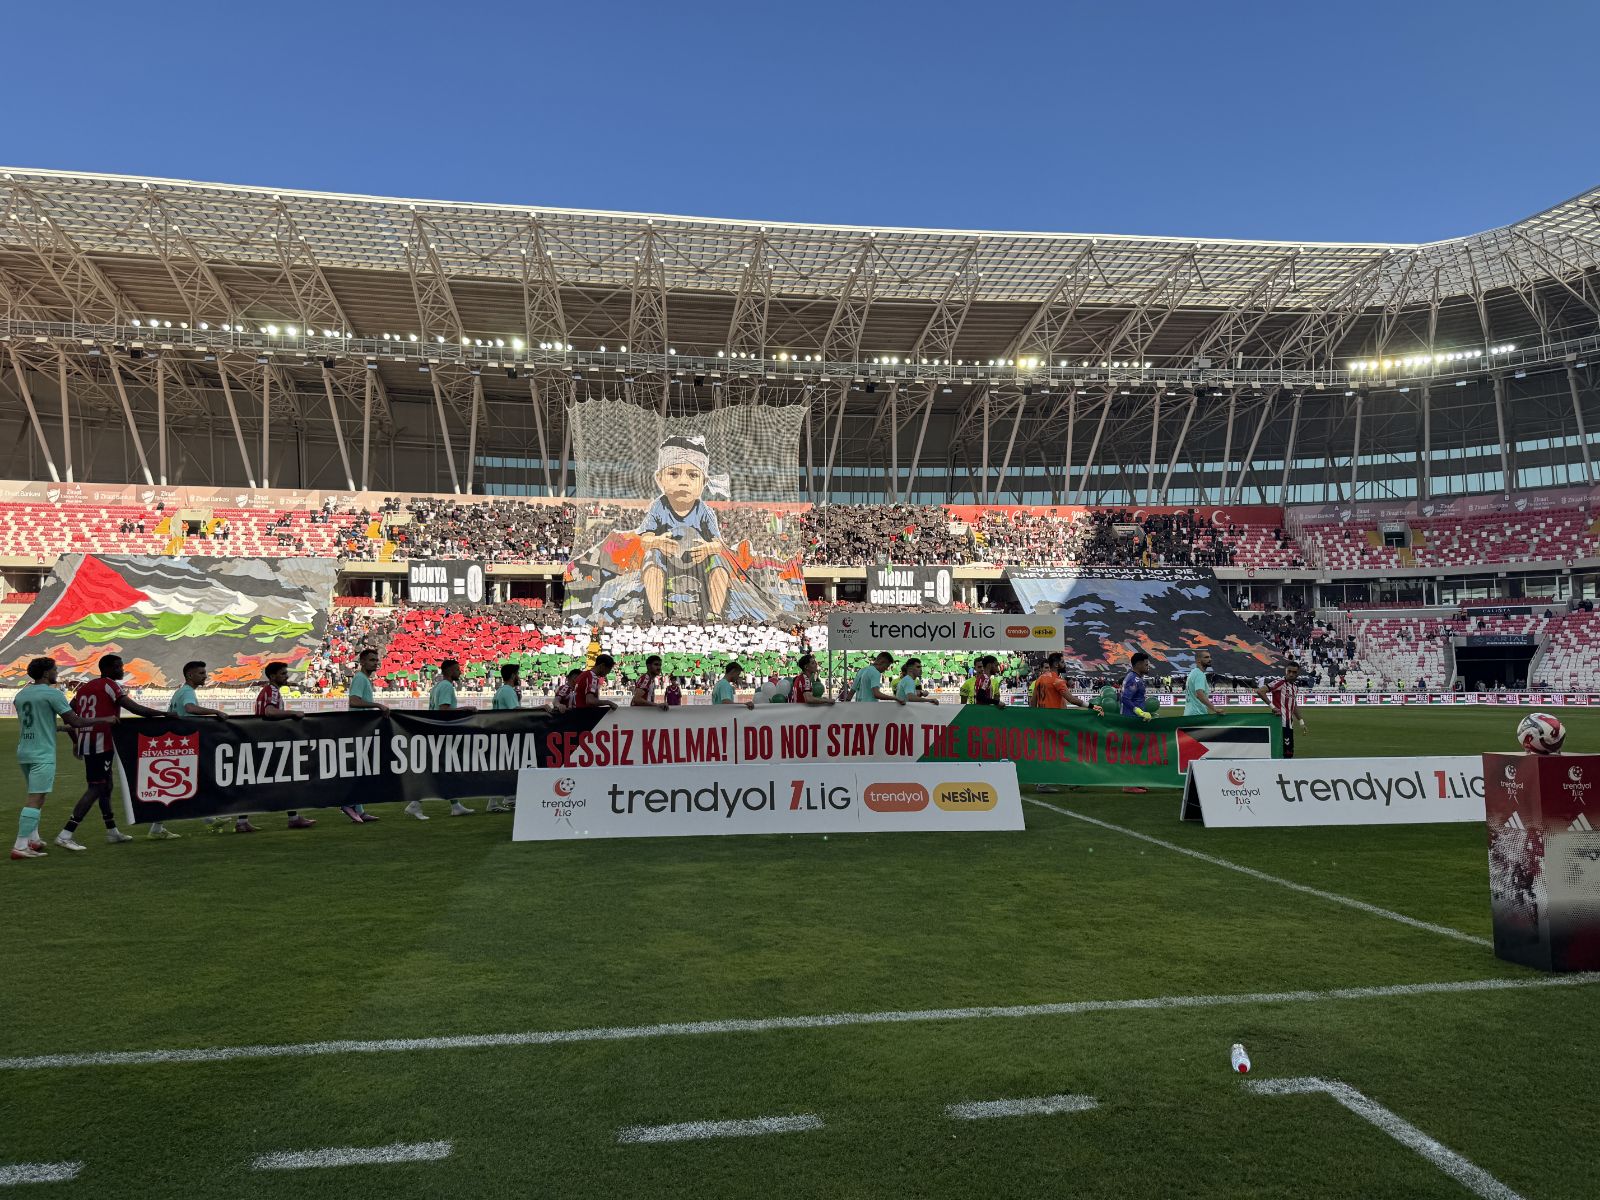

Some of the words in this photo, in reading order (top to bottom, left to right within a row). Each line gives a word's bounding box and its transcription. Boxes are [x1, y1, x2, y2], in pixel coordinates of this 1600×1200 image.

[410, 586, 449, 603] WORLD
[869, 620, 956, 642] trendyol
[22, 701, 33, 729] 3
[79, 694, 97, 719] 23
[390, 732, 538, 774] SOYKIRIMA
[546, 724, 634, 769] SESSİZ
[642, 726, 728, 765] KALMA!
[743, 726, 774, 761] DO
[780, 724, 821, 760] NOT
[827, 722, 880, 758] STAY
[885, 722, 915, 757] ON
[921, 723, 961, 757] THE
[967, 725, 1071, 763] GENOCIDE
[1077, 731, 1098, 764] IN
[1107, 732, 1169, 766] GAZA!
[141, 790, 158, 798] 1967
[1221, 787, 1261, 797] trendyol
[1276, 770, 1426, 806] trendyol
[1500, 781, 1524, 790] trendyol
[1563, 782, 1592, 790] trendyol
[541, 798, 586, 809] trendyol
[607, 780, 775, 818] trendyol
[870, 790, 923, 804] trendyol
